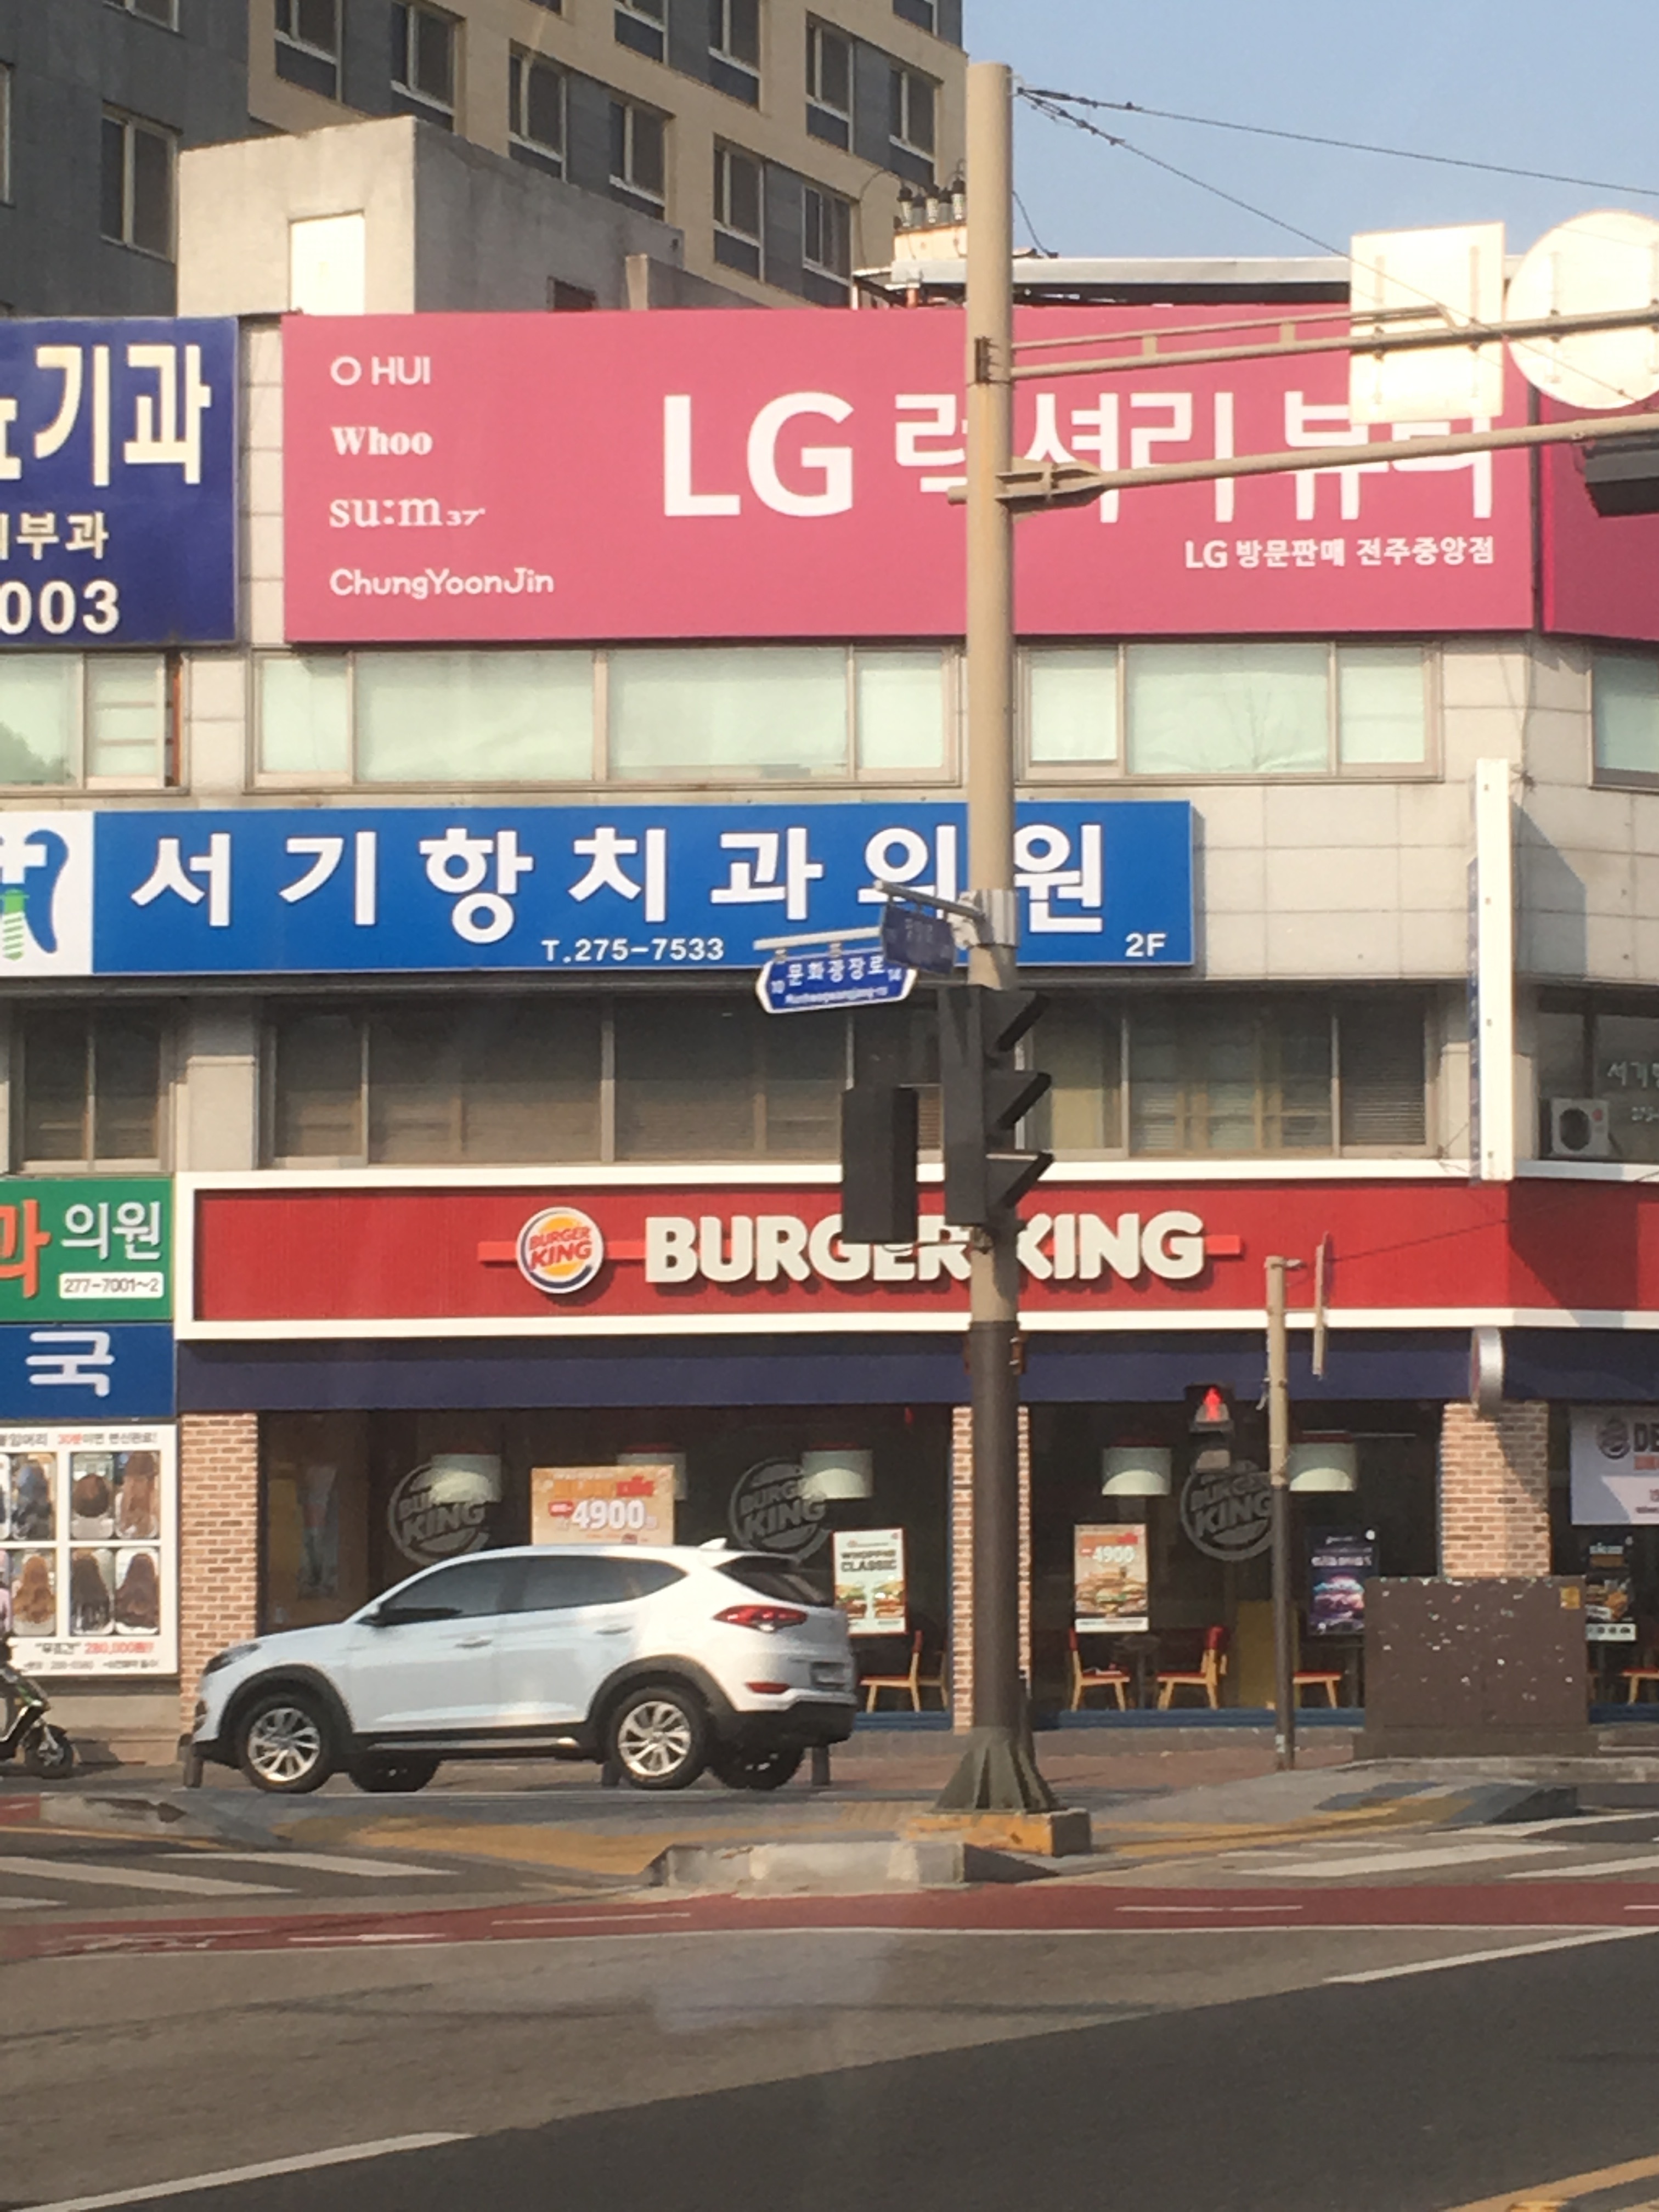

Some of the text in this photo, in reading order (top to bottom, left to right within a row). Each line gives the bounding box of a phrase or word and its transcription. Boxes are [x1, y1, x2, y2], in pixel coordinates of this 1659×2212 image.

[330, 356, 431, 385] O HUI
[331, 426, 432, 455] Whoo
[664, 392, 854, 517] LG
[1185, 536, 1494, 568] LG 방문판매 전주중앙점
[329, 567, 554, 599] ChungYoonJin
[1124, 932, 1166, 958] 2F
[61, 1201, 161, 1260] 의원
[529, 1227, 591, 1251] BURGER
[529, 1239, 592, 1273] KING
[25, 1331, 116, 1398] 국
[401, 1502, 486, 1544] KING
[572, 1499, 645, 1530] 4900
[742, 1497, 827, 1538] KING
